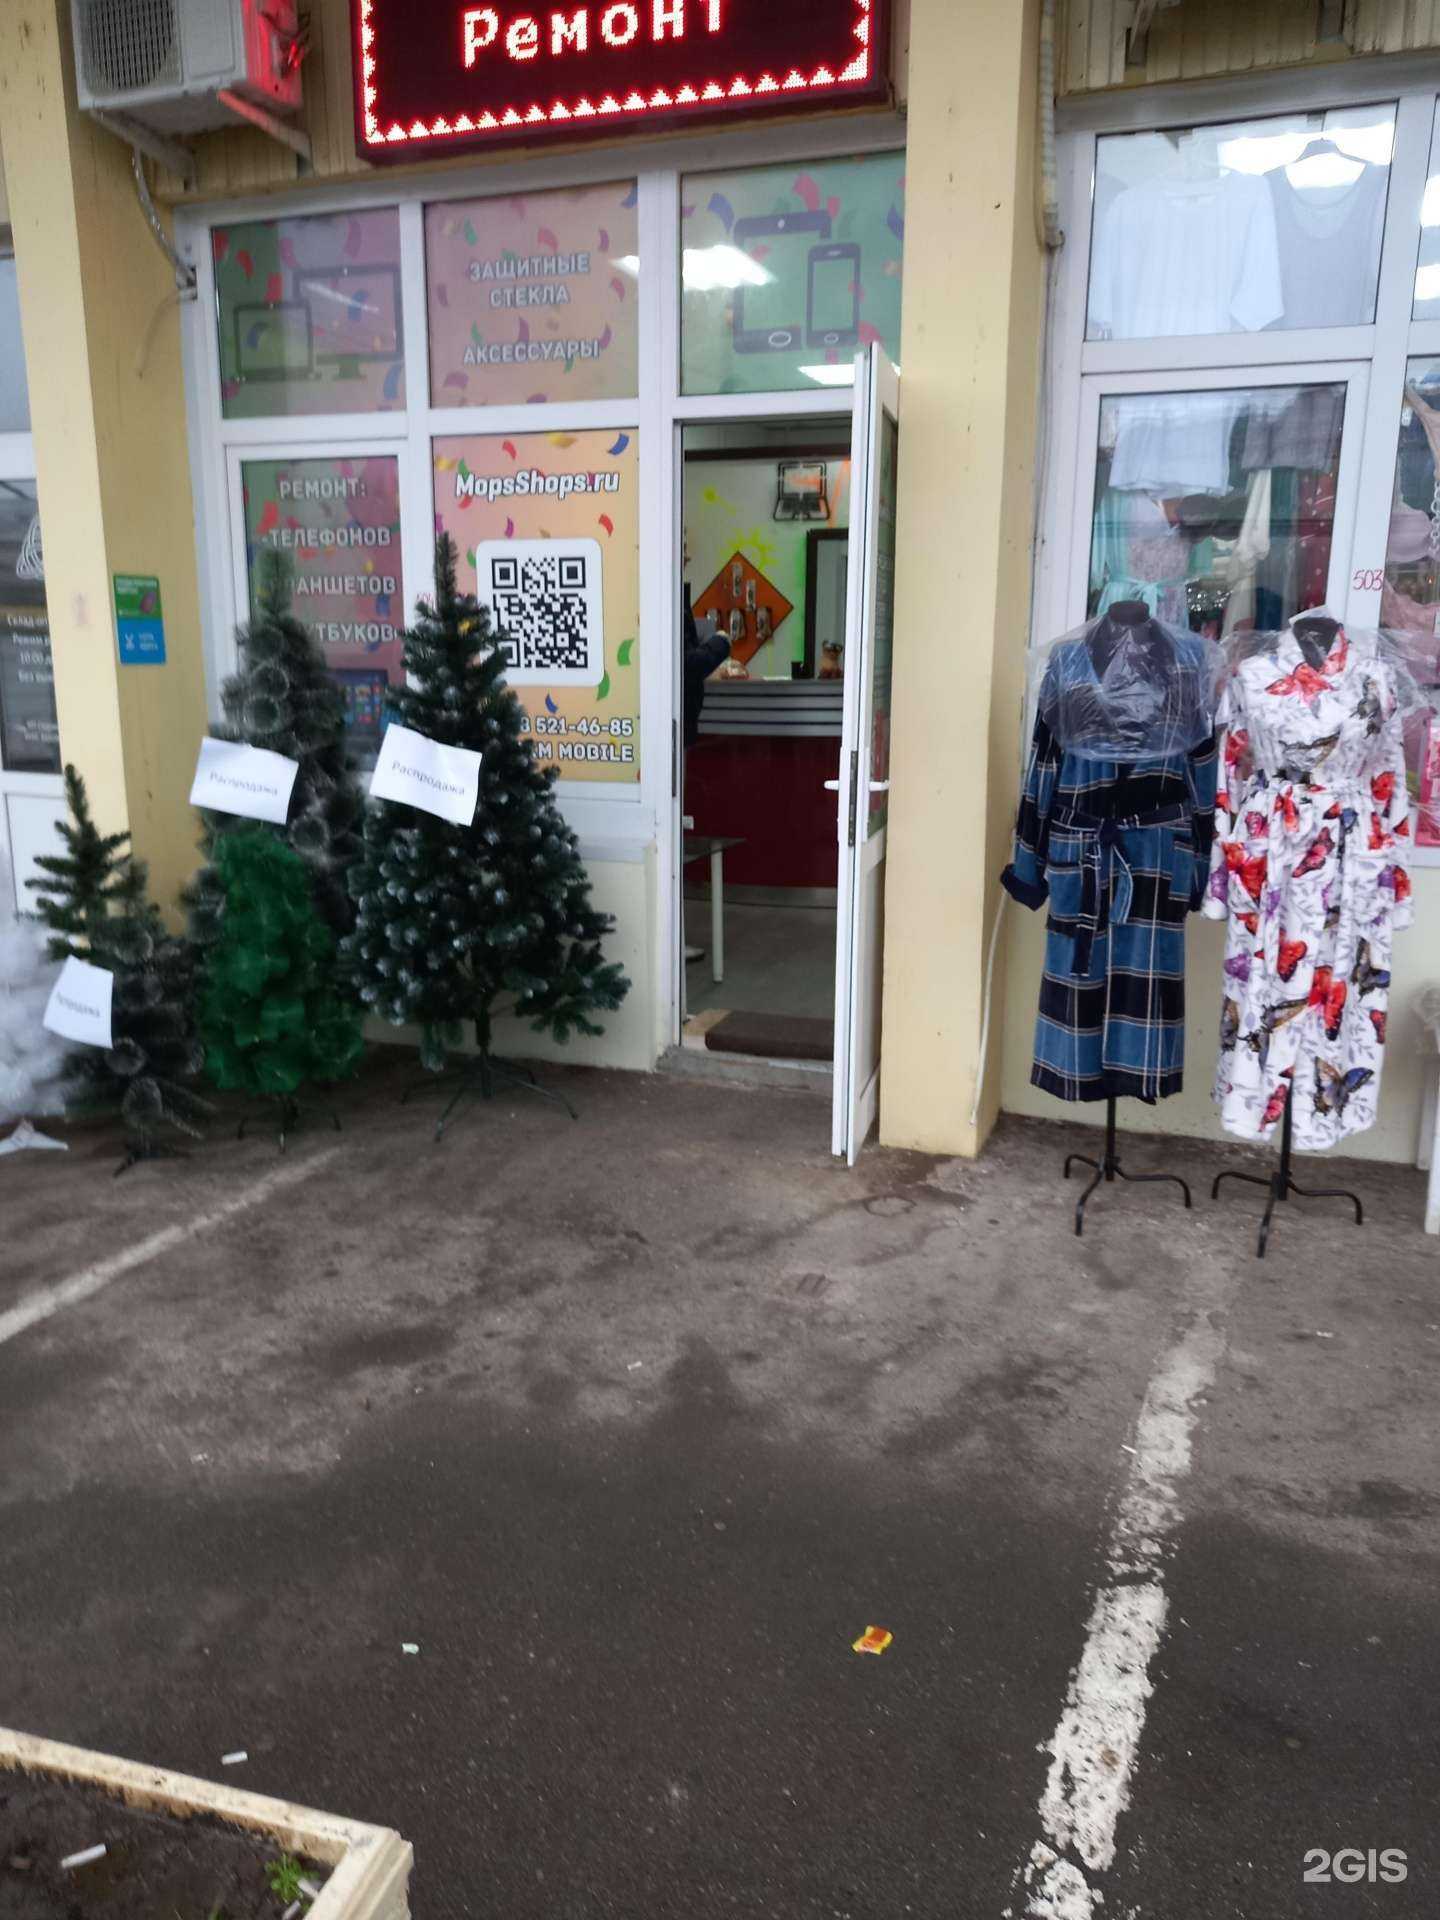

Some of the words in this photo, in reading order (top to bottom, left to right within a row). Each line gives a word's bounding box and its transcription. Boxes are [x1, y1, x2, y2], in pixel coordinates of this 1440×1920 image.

[469, 252, 592, 282] ЗАЩИТНЫЕ
[489, 284, 571, 309] СТЕКЛА
[462, 338, 601, 366] АКСЕССУАРЫ
[279, 477, 368, 500] РЕМОНТ:
[455, 470, 620, 503] MopsShops.ru
[1352, 568, 1384, 592] 503
[536, 715, 634, 737] 521-46-85
[558, 742, 635, 763] MOBILE
[390, 760, 466, 796] Распродажа
